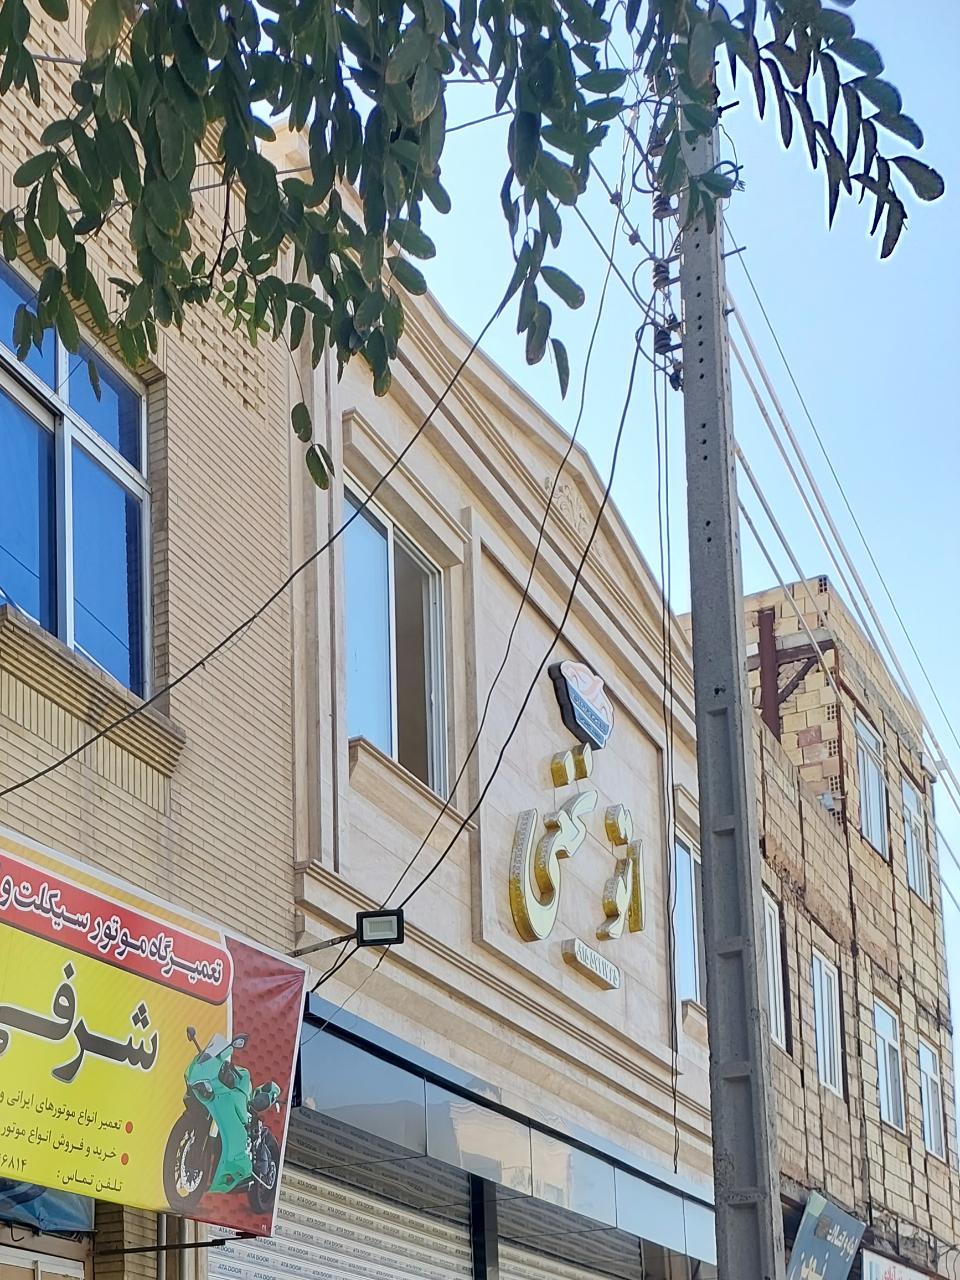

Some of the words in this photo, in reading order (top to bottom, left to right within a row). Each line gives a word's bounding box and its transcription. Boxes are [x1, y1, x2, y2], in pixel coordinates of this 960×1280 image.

[12, 882, 89, 931] سیکلت
[88, 915, 147, 958] موتور
[149, 932, 223, 984] تعمیرگاه
[0, 1090, 5, 1103] و
[6, 1090, 34, 1110] ایرانی
[35, 1097, 76, 1121] موتورهای
[77, 1111, 98, 1127] انواع
[98, 1118, 122, 1131] تعمیر
[1, 1122, 26, 1137] موتور
[28, 1129, 51, 1145] انواع
[52, 1134, 84, 1152] فروش
[84, 1145, 90, 1157] و
[92, 1145, 117, 1161] خرید
[95, 1178, 123, 1192] تلفن
